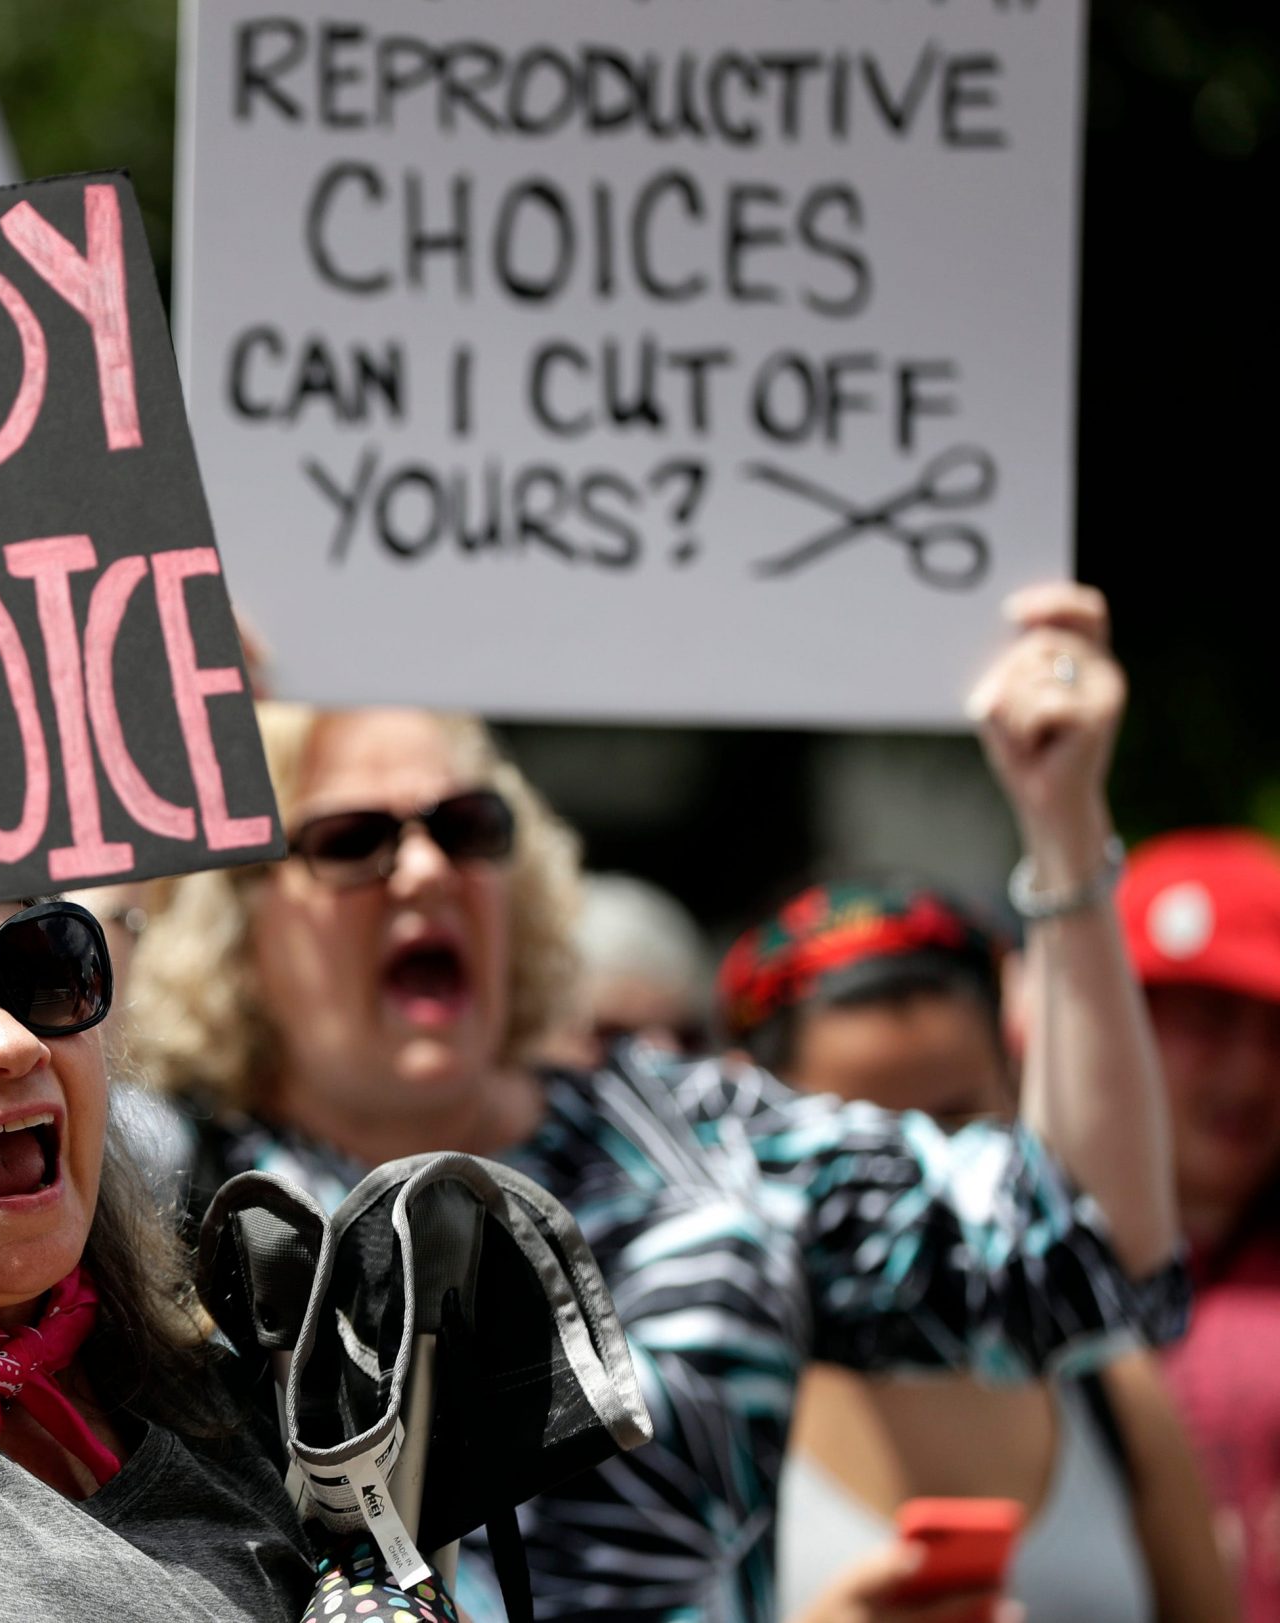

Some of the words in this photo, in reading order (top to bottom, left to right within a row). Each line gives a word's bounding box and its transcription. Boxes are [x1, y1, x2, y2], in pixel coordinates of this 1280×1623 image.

[231, 15, 1010, 150] REPRODUCTIVE
[305, 158, 874, 319] CHOICES
[225, 324, 408, 428] CAN
[450, 341, 473, 437] I
[528, 333, 733, 440] CUT
[748, 347, 961, 455] OFF
[302, 444, 708, 572] YOURS?
[388, 1545, 405, 1569] CHINA
[393, 1536, 408, 1559] MADE
